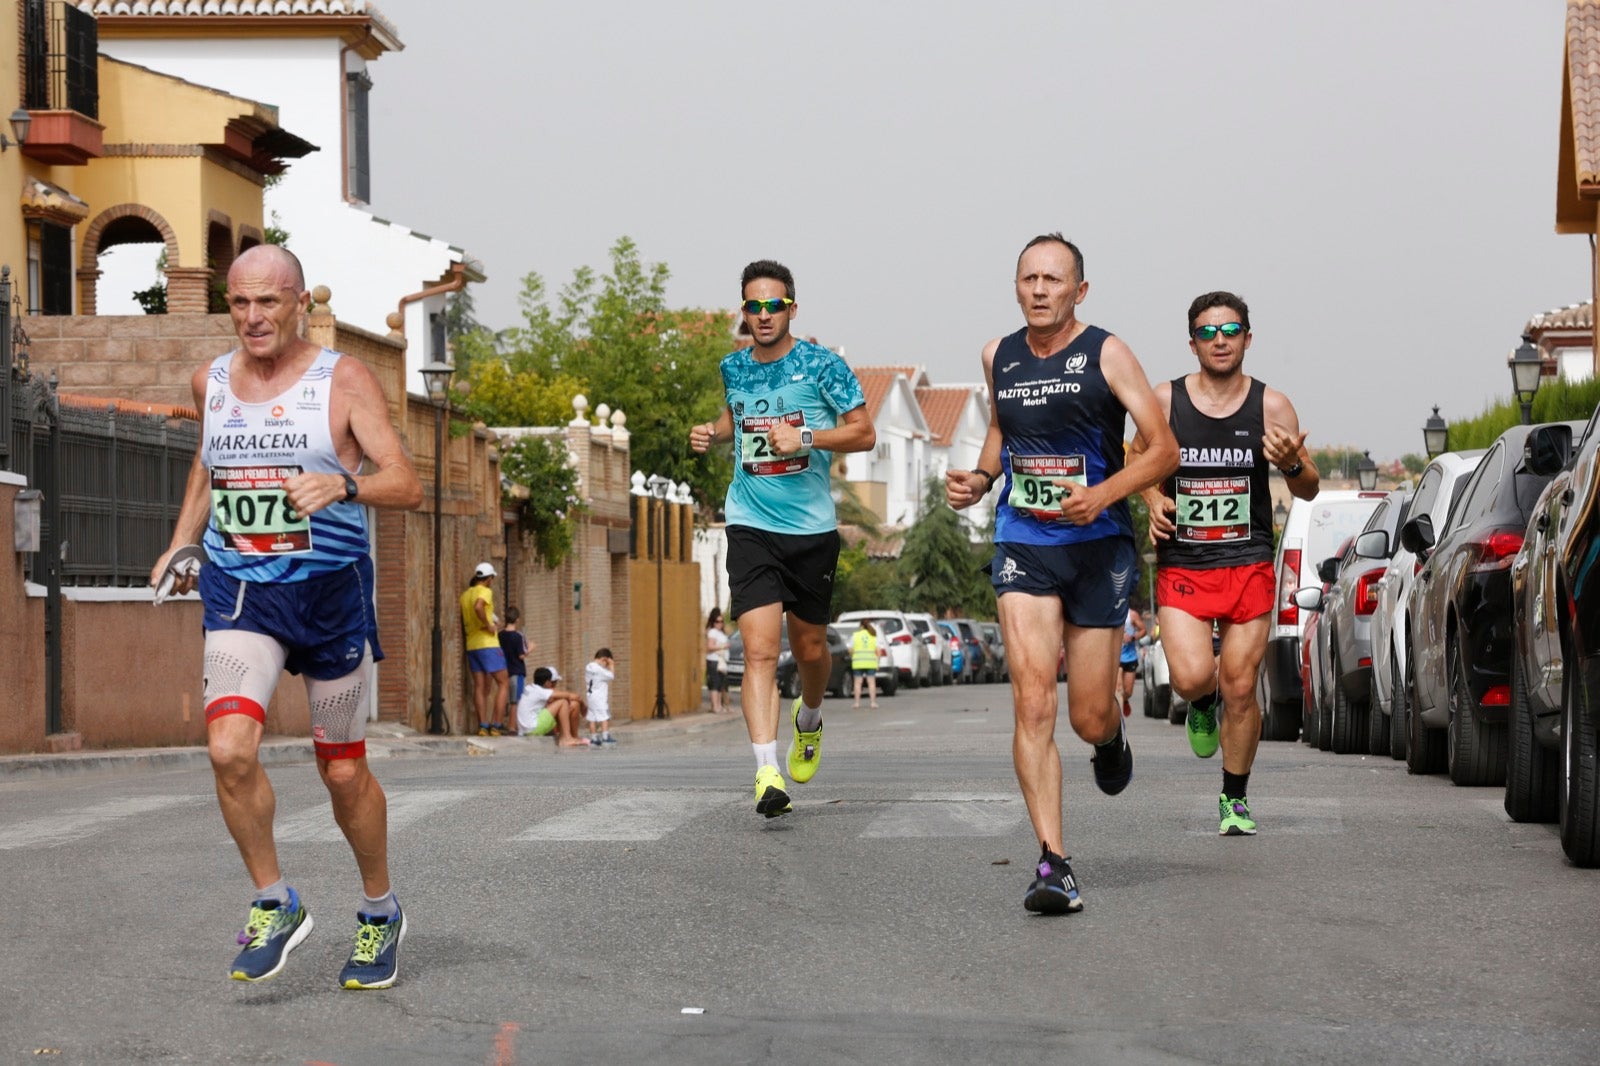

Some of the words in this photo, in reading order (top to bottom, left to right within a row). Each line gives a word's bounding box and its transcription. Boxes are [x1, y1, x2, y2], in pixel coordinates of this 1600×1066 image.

[998, 388, 1031, 400] PAZITO
[1032, 389, 1040, 397] a
[1041, 383, 1081, 395] PAZITO
[1023, 396, 1047, 407] Motril
[209, 433, 308, 451] MARACENA
[252, 451, 295, 459] ATLETISMO
[1180, 447, 1254, 463] GRANADA
[1035, 458, 1056, 468] PREMIO
[1056, 458, 1063, 468] DE
[227, 468, 244, 480] GRAN
[244, 468, 269, 480] PREMIO
[269, 468, 278, 479] DE
[1191, 480, 1204, 488] GRAN
[1205, 480, 1223, 488] PREMIO
[1223, 480, 1230, 488] DE
[1230, 479, 1246, 488] FONDO
[1188, 498, 1239, 522] 212
